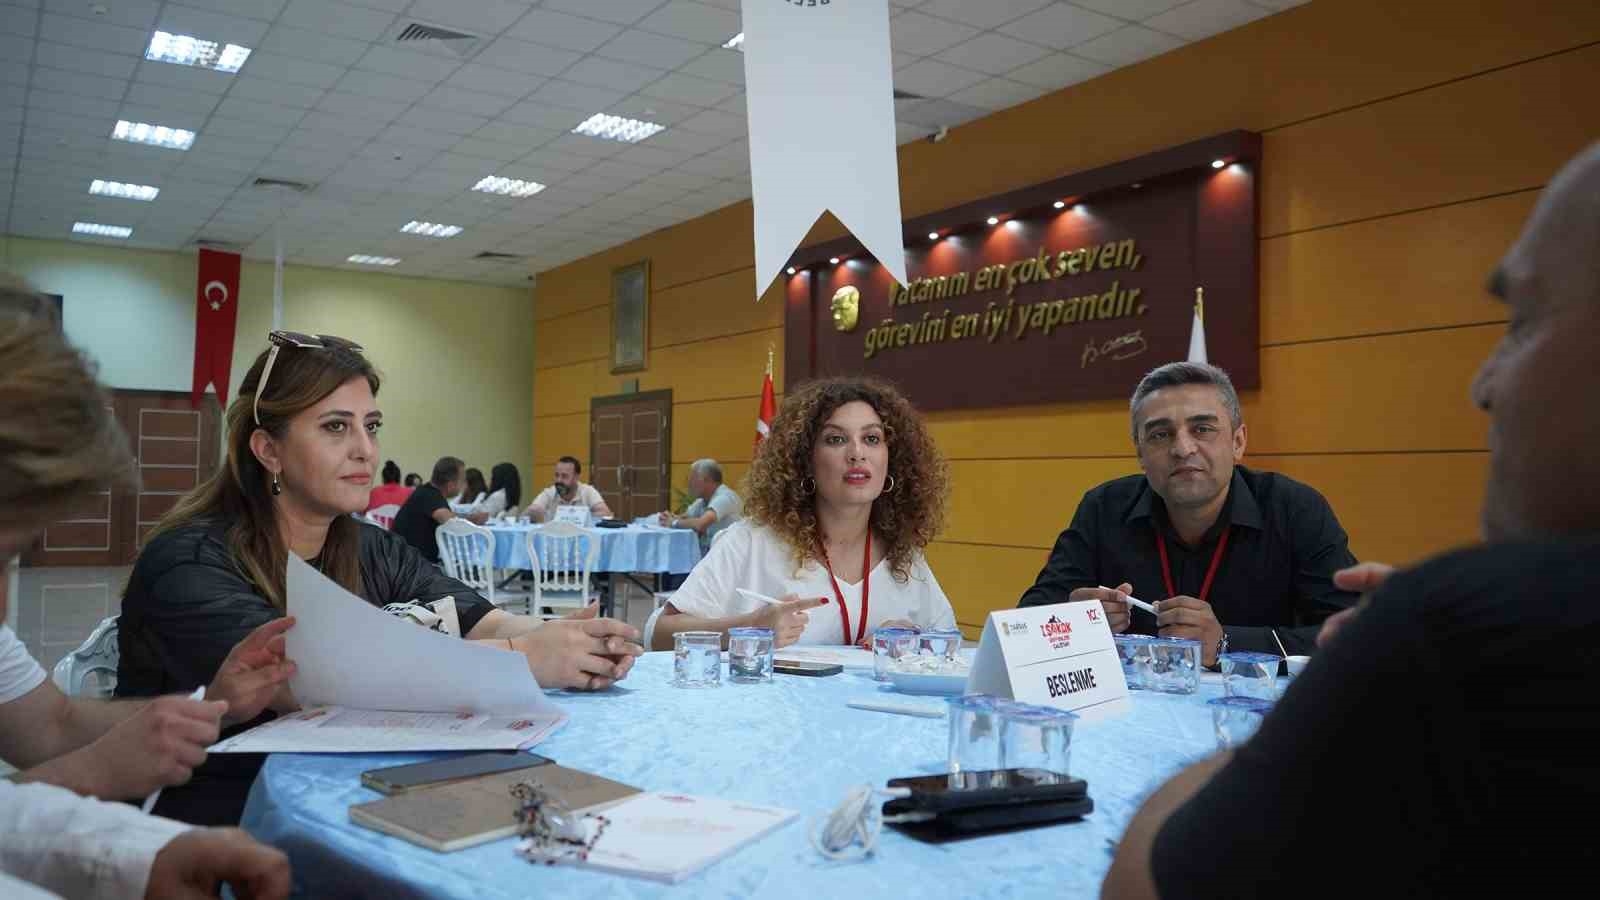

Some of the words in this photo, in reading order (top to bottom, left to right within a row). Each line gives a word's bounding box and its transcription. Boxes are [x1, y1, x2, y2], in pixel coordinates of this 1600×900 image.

[974, 262, 1007, 291] en
[1006, 249, 1051, 294] çok
[1054, 237, 1141, 279] seven,
[863, 308, 950, 358] görevini
[951, 312, 980, 339] en
[982, 299, 1015, 343] iyi
[1016, 280, 1147, 340] yapandır.
[1046, 667, 1097, 699] BESLENME
